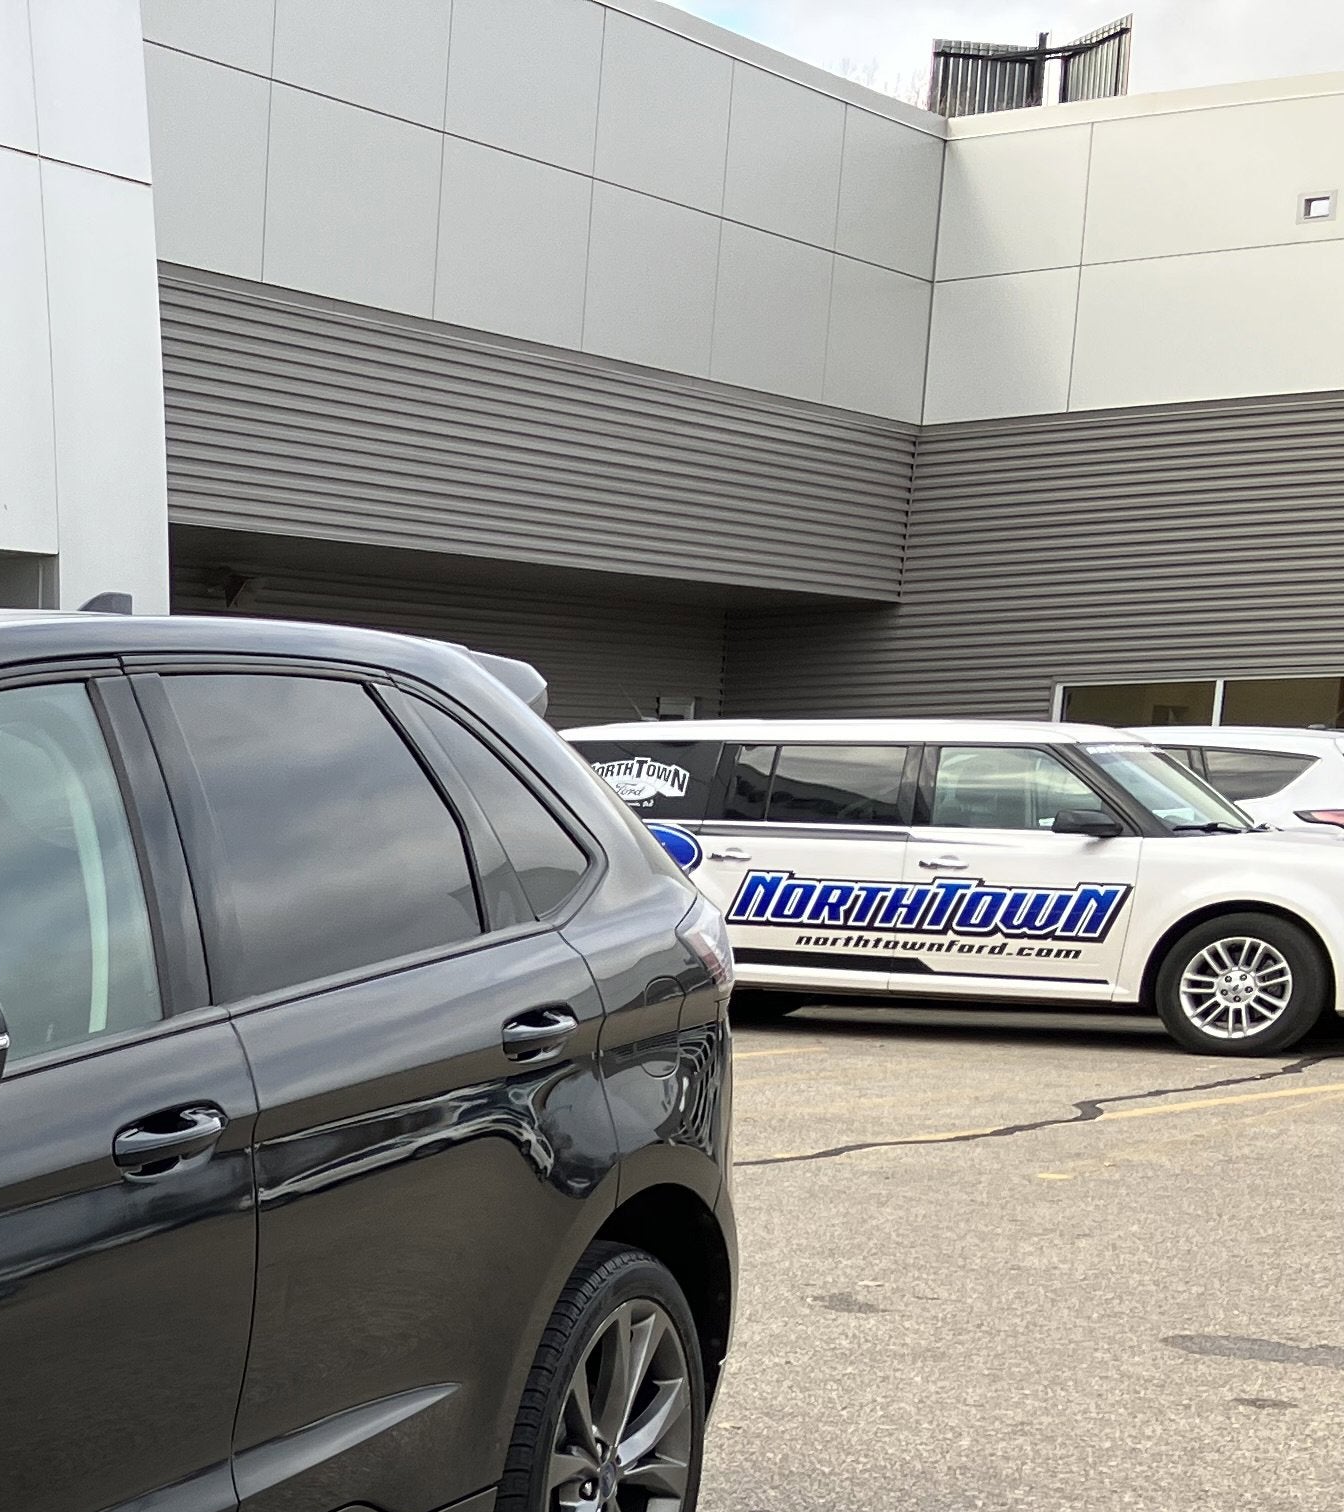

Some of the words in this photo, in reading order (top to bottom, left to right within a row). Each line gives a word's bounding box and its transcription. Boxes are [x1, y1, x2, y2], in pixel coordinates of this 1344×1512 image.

[592, 757, 688, 793] ORTHTOWN
[615, 782, 646, 796] Ford
[728, 871, 1132, 942] NORTHTOWN
[796, 934, 1082, 960] northtownford.com
